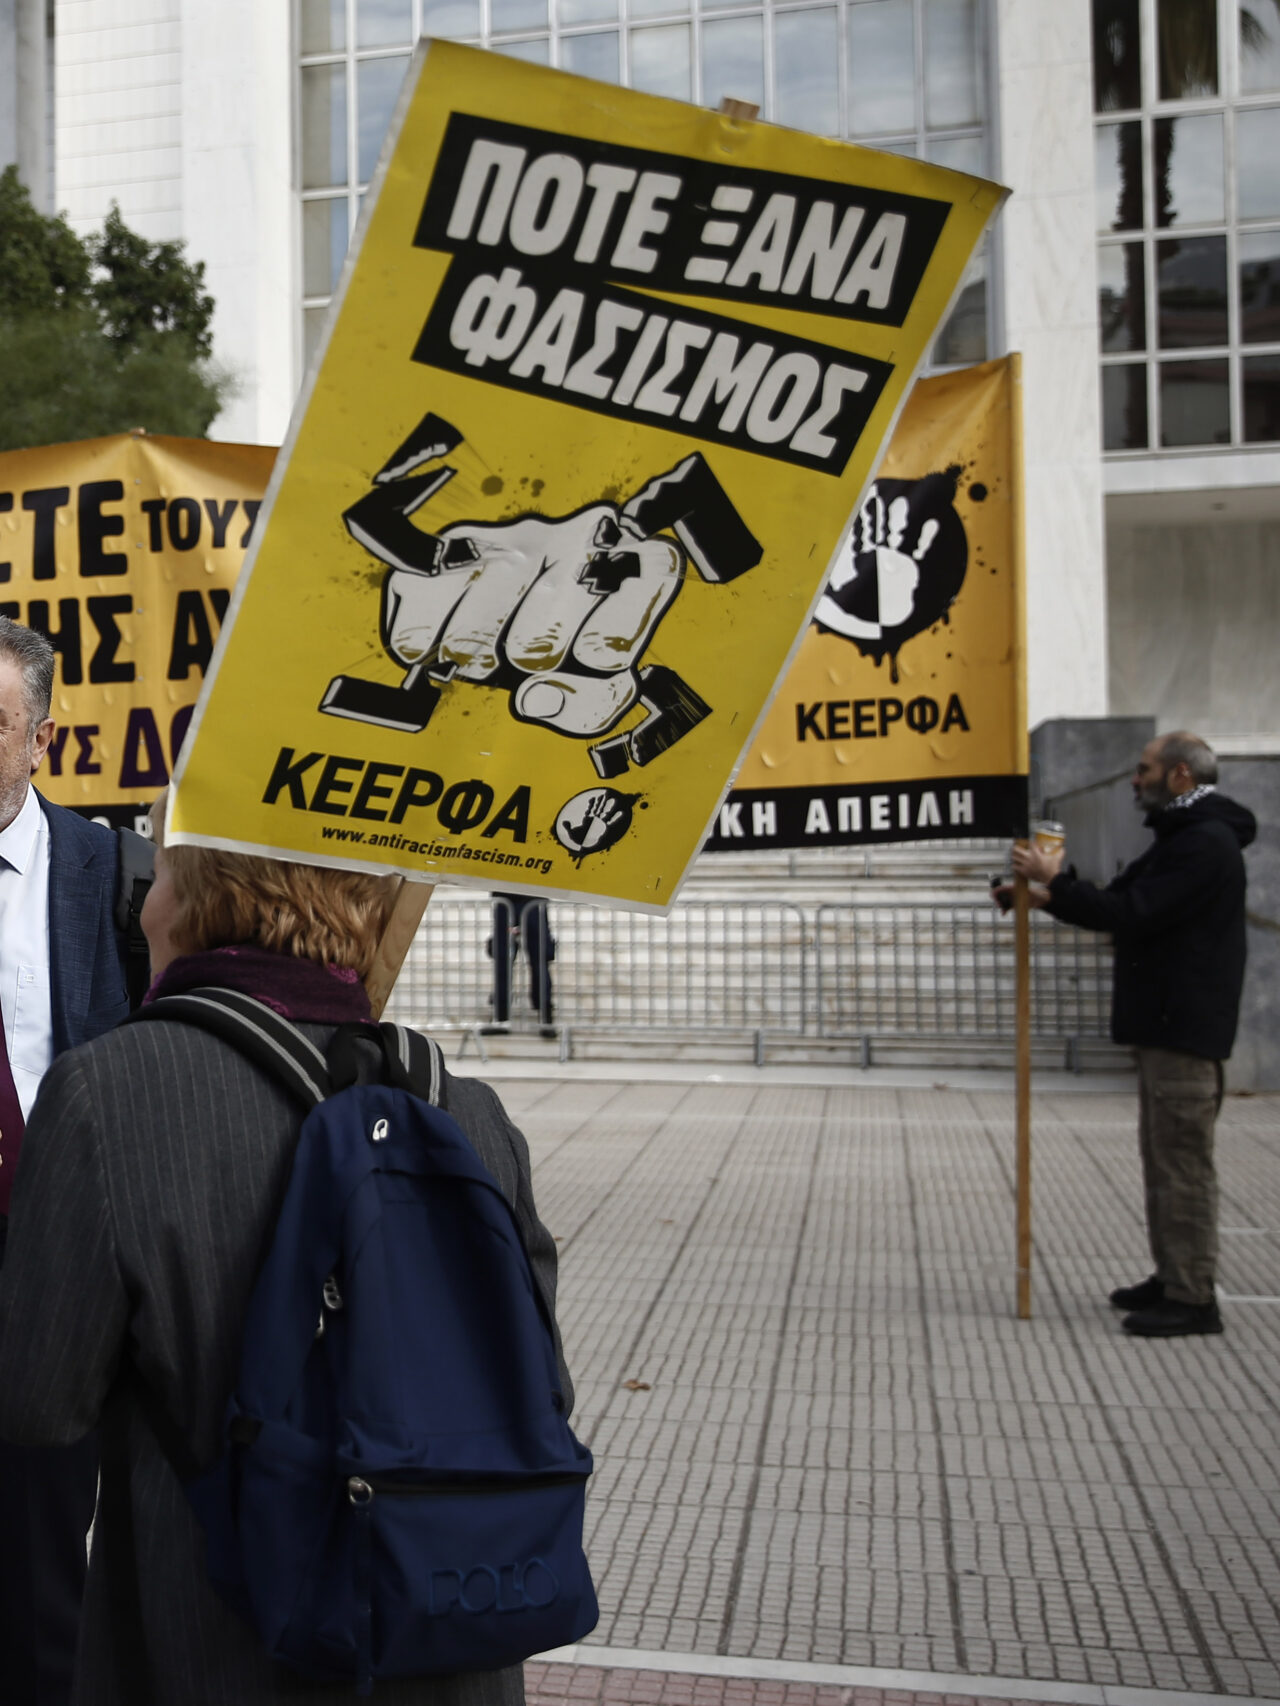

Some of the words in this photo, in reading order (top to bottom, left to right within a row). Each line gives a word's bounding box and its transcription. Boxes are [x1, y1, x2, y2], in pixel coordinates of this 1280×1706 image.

[445, 138, 682, 273] ΠΟΤΕ
[684, 184, 907, 309] ΞΑΝΑ
[449, 267, 869, 459] ΦΑΣΙΣΜΟΣ
[795, 693, 971, 742] ΚΕΕΡΦΑ
[261, 747, 532, 843] ΚΕΕΡΦΑ
[708, 801, 777, 838] ΚΗ
[804, 789, 974, 834] ΑΠΕΙΛΗ
[321, 825, 553, 874] www.antiracismfascism.org
[428, 1557, 559, 1615] POLO
